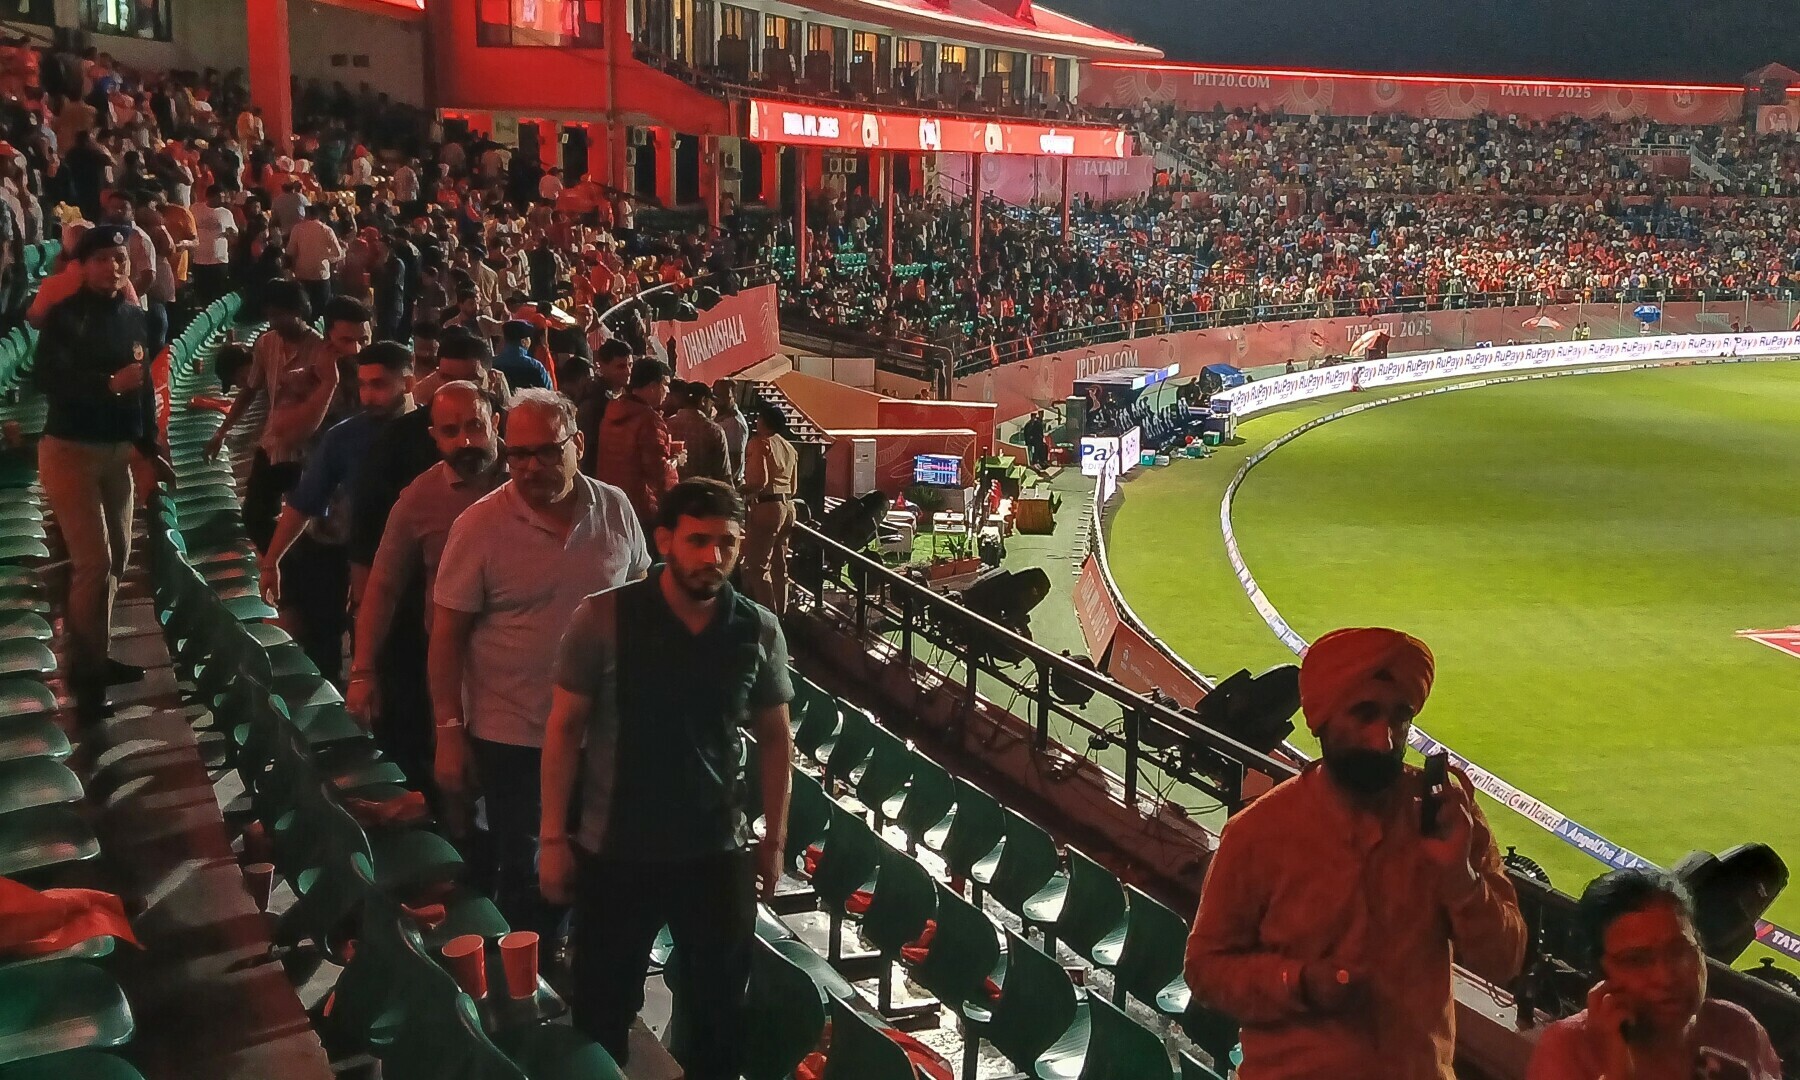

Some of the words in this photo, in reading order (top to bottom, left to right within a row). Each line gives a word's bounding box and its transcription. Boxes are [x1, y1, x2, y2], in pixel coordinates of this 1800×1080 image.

[1193, 72, 1270, 89] IPLT20.COM
[1499, 84, 1530, 97] TATA
[1533, 86, 1553, 98] IPL
[1557, 86, 1592, 99] 2025
[1399, 320, 1433, 337] 2025
[682, 314, 747, 369] DHARAMSHALA
[1250, 384, 1270, 401] RuPay
[1273, 379, 1296, 395] RuPay
[1299, 373, 1321, 390] RuPay
[1325, 369, 1347, 385] RuPay
[1378, 362, 1403, 377] RuPay
[1406, 359, 1432, 373] RuPay
[1436, 355, 1460, 369] RuPay
[1464, 352, 1490, 366] RuPay
[1494, 349, 1521, 364] RuPay
[1525, 347, 1552, 361] RuPay
[1557, 344, 1584, 359] RuPay
[1588, 343, 1616, 356] RuPay
[1621, 341, 1649, 354] RuPay
[1653, 339, 1682, 352] RuPay
[1688, 338, 1717, 351] RuPay
[1759, 335, 1788, 348] RuPay
[1567, 827, 1616, 860] AngelOne
